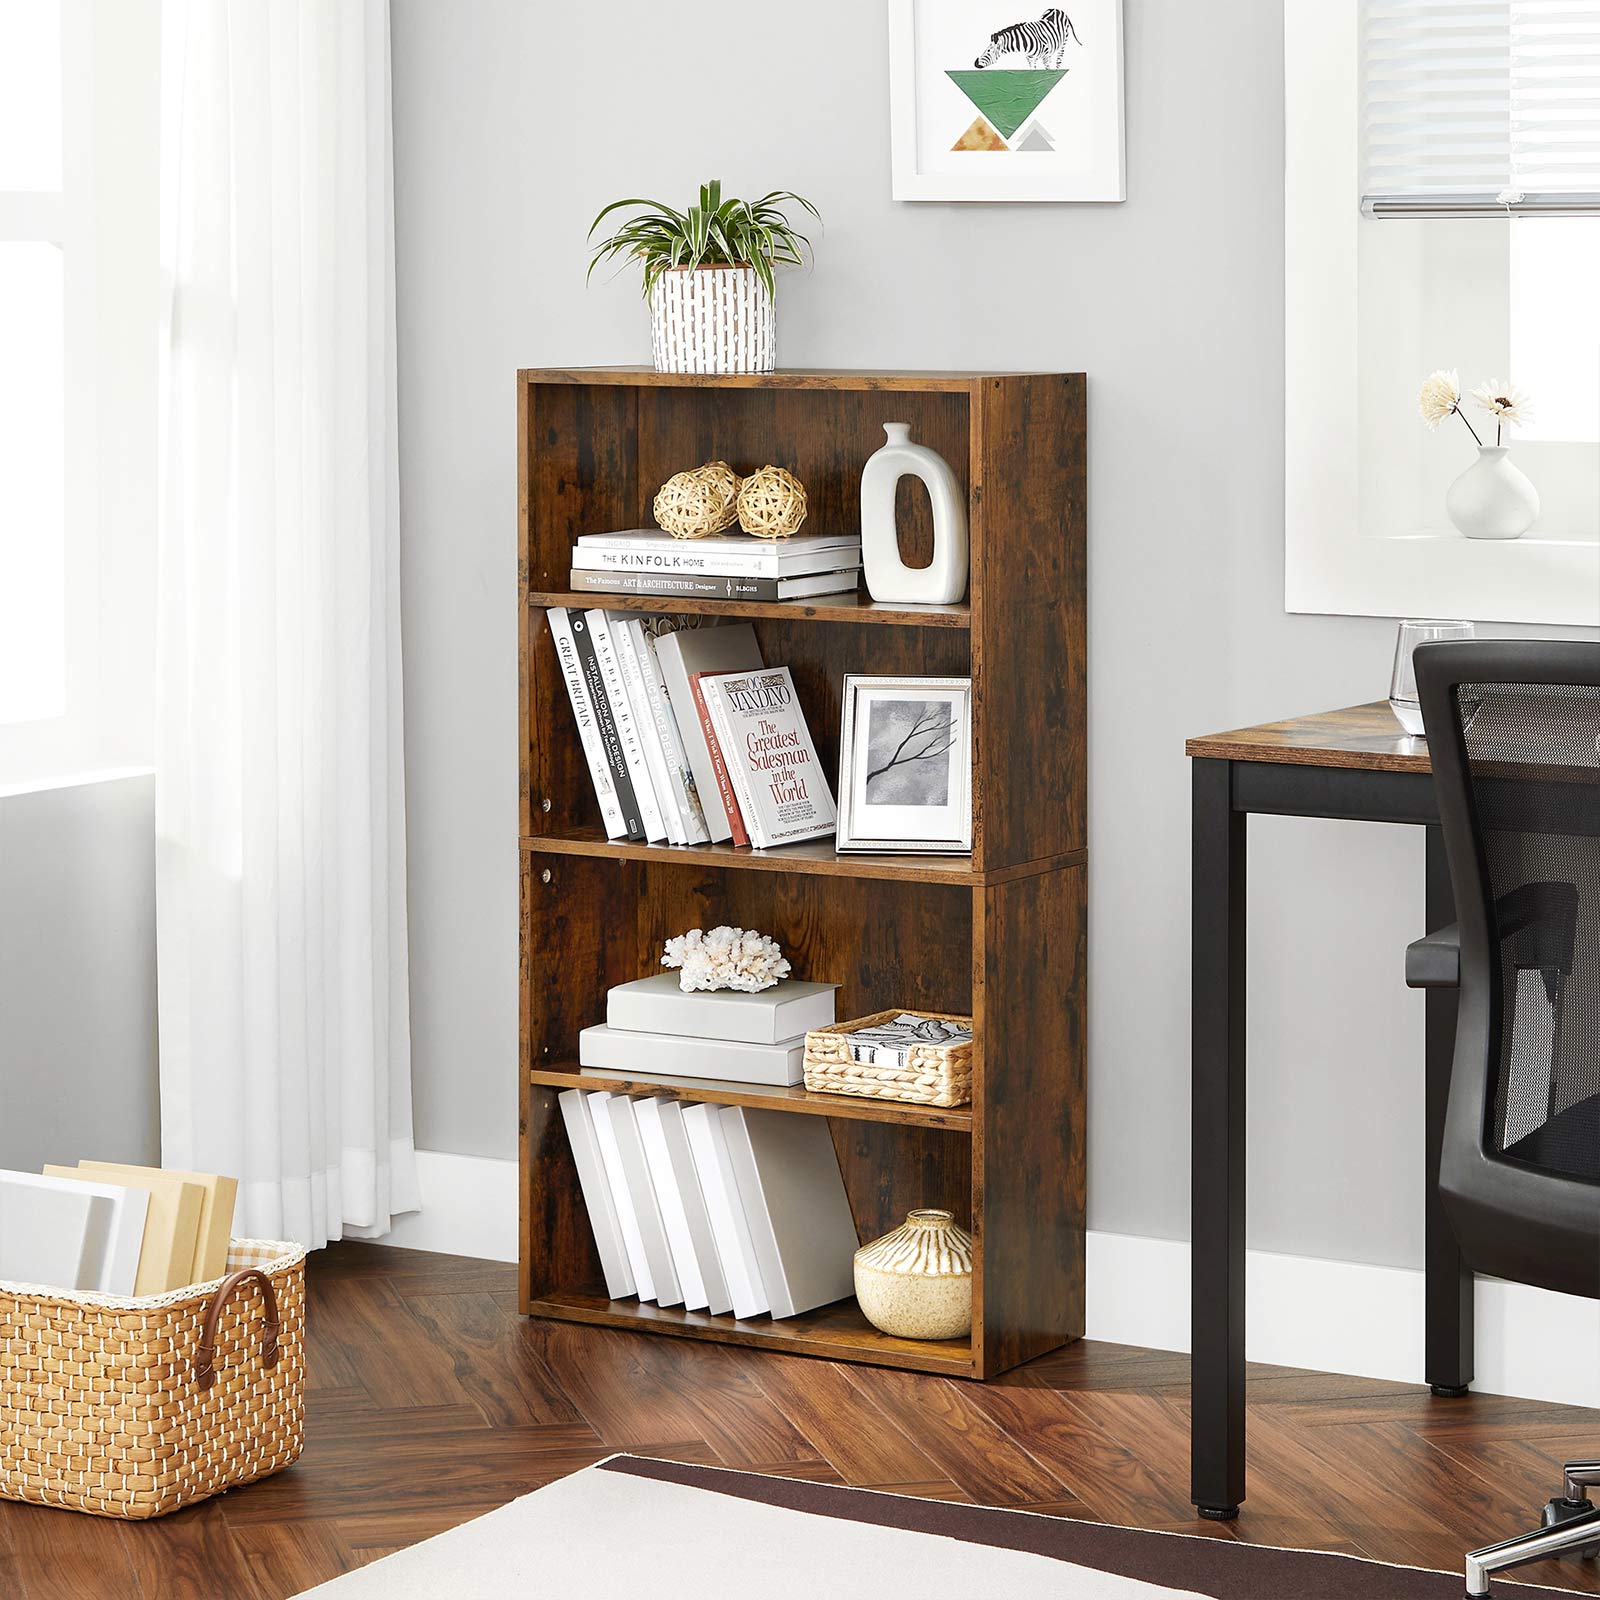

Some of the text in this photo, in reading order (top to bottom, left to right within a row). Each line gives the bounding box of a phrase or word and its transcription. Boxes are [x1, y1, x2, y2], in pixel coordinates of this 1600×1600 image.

[602, 554, 617, 563] THE
[621, 554, 681, 567] KINFOLK
[682, 558, 705, 567] HOME
[585, 576, 597, 584] The
[597, 577, 620, 585] Famous
[623, 578, 636, 588] ART
[642, 579, 694, 590] ARCHITECTURE
[695, 583, 717, 591] Designer
[559, 636, 577, 677] GREAT
[571, 679, 591, 728] BRITAIN
[747, 676, 763, 690] OG
[728, 686, 791, 712] MANDINO
[587, 656, 609, 718] INSTALLATION
[605, 718, 614, 734] ART
[612, 745, 626, 777] DESIGN
[639, 654, 656, 693] PUBLIC
[650, 695, 667, 732] SPACE
[661, 734, 678, 775] DESIGN
[704, 719, 713, 735] What
[758, 720, 776, 736] The
[746, 728, 800, 753] Greatest
[748, 748, 810, 772] Salesman
[771, 766, 796, 783] in the
[769, 778, 809, 805] World
